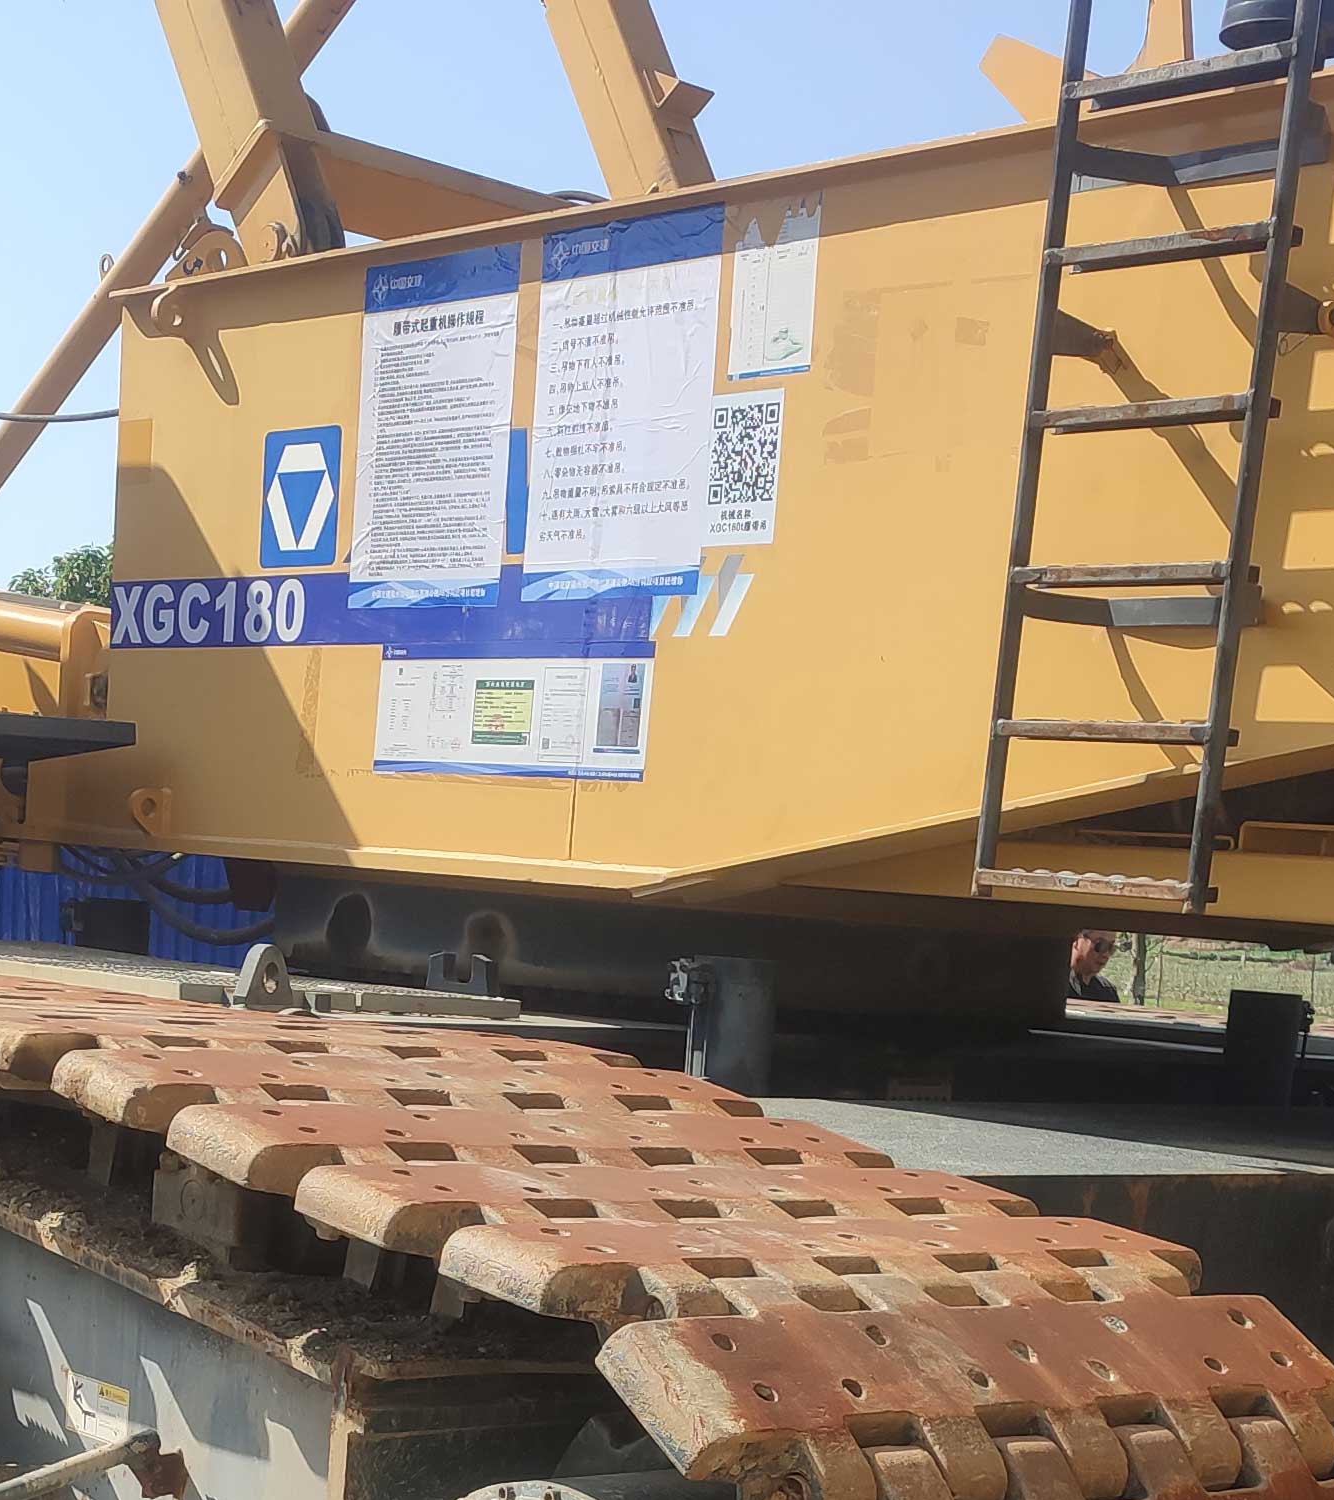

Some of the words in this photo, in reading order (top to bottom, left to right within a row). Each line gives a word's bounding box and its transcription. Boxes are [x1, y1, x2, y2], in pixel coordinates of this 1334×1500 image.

[393, 310, 485, 336] 履带式起重机操作规程
[111, 578, 305, 644] XGC180
